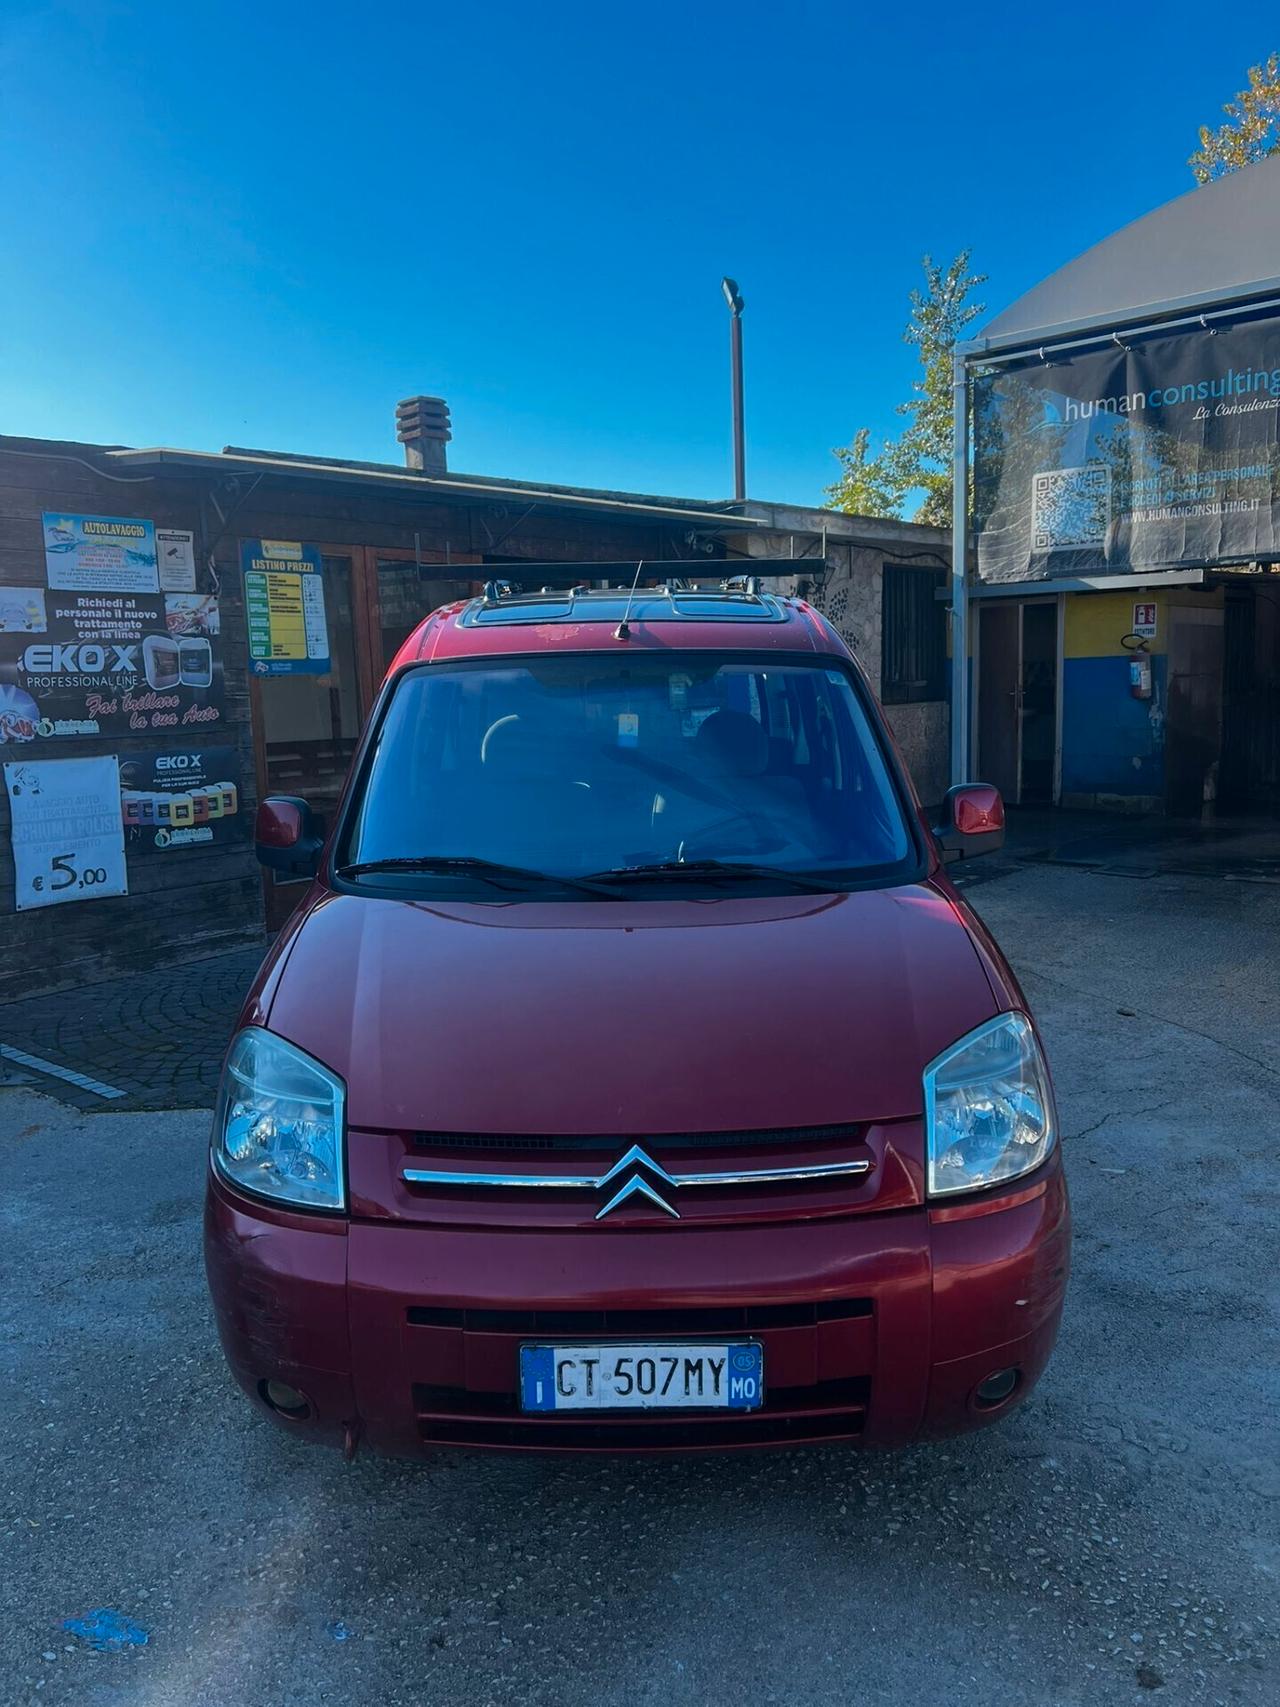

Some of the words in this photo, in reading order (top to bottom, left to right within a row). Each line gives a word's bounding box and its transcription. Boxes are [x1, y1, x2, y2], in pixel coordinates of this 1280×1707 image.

[1192, 406, 1211, 420] La
[84, 522, 145, 536] AUTOLAVAGGIO
[252, 559, 285, 571] LISTINO
[287, 561, 314, 573] PREZZI
[77, 598, 124, 608] Richiedi
[125, 599, 135, 608] al
[55, 608, 112, 619] personale
[114, 609, 122, 618] il
[124, 611, 158, 619] nuovo
[74, 619, 142, 629] trattamento
[78, 631, 99, 639] con
[101, 630, 112, 639] la
[114, 630, 141, 639] linea
[27, 676, 114, 688] PROFESSIONAL
[116, 675, 138, 686] LINE
[86, 695, 117, 718] Fai
[122, 692, 180, 712] brillare
[129, 711, 148, 729] la
[152, 711, 178, 727] tua
[182, 704, 219, 725] Auto
[76, 815, 121, 837] POLISH
[32, 876, 44, 891] €
[51, 853, 107, 891] 5,00
[557, 1359, 600, 1397] CT
[613, 1358, 726, 1396] 507MY
[731, 1378, 755, 1399] MO
